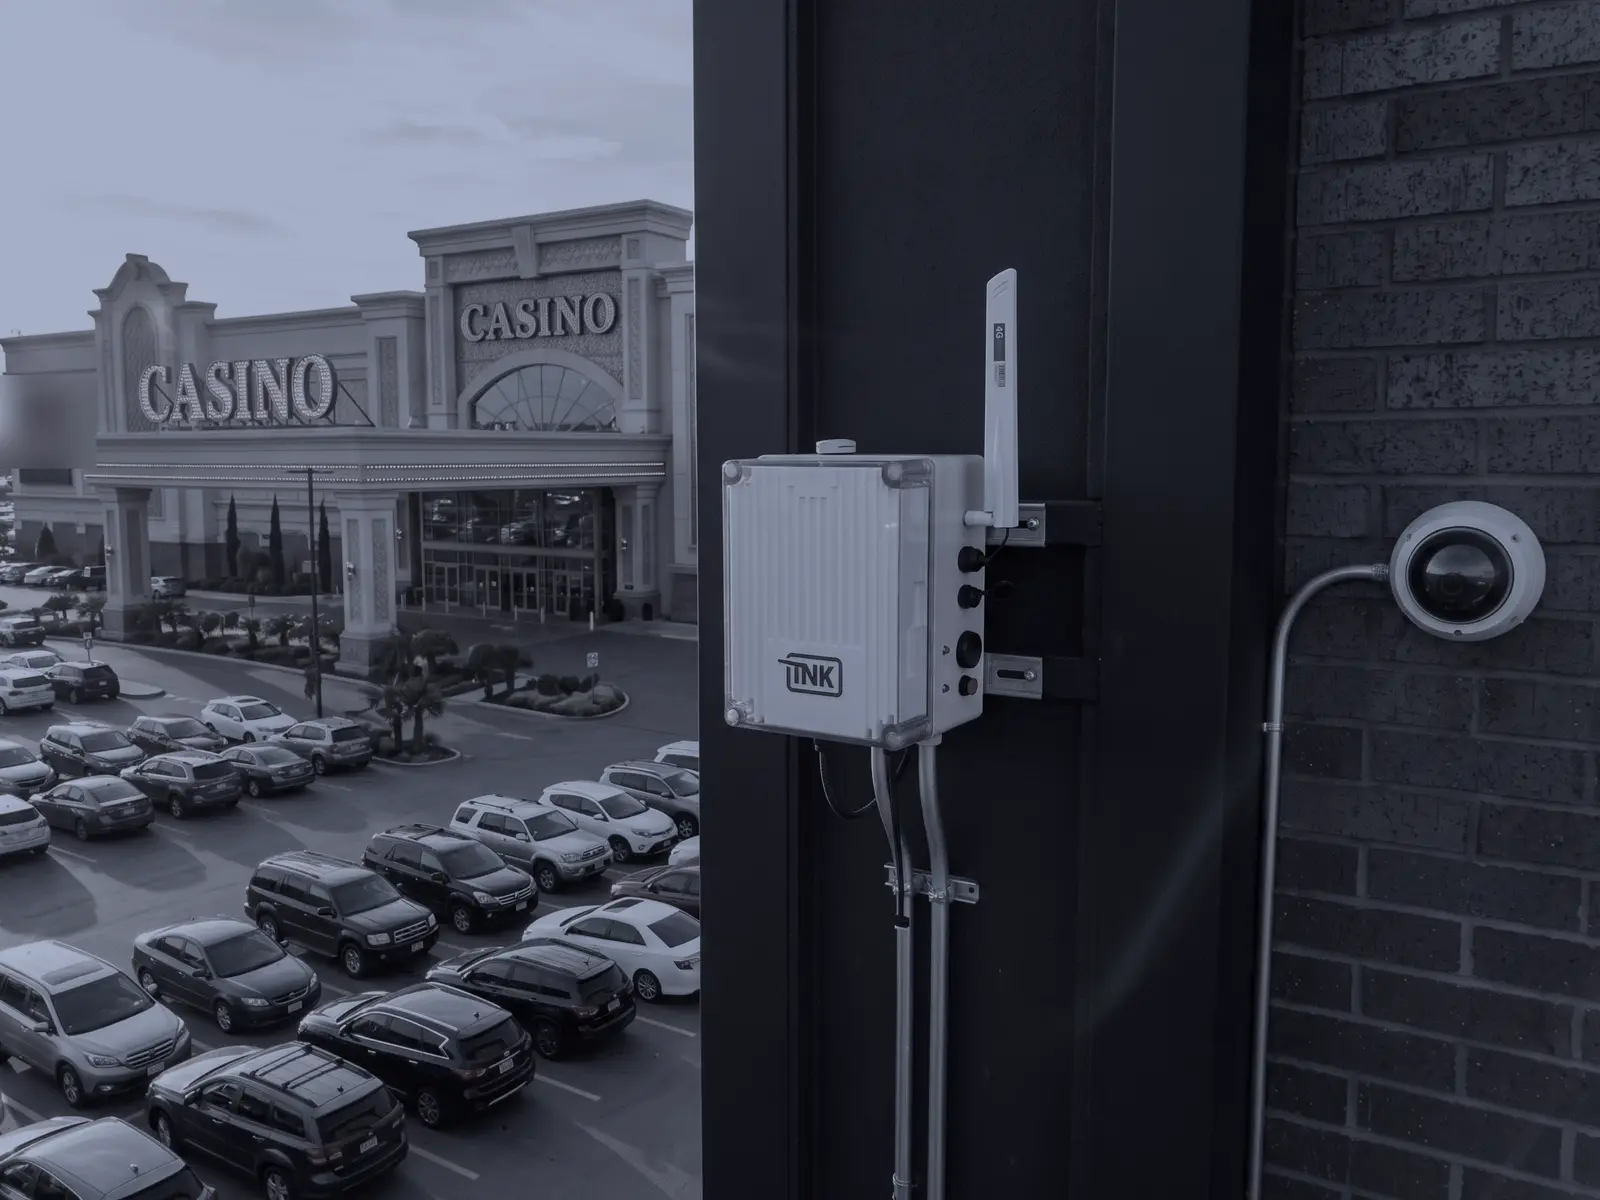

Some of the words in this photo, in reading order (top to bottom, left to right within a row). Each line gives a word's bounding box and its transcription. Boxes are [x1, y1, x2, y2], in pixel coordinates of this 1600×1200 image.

[460, 292, 617, 342] CASINO
[995, 326, 1003, 339] 4G
[139, 354, 334, 423] CASINO
